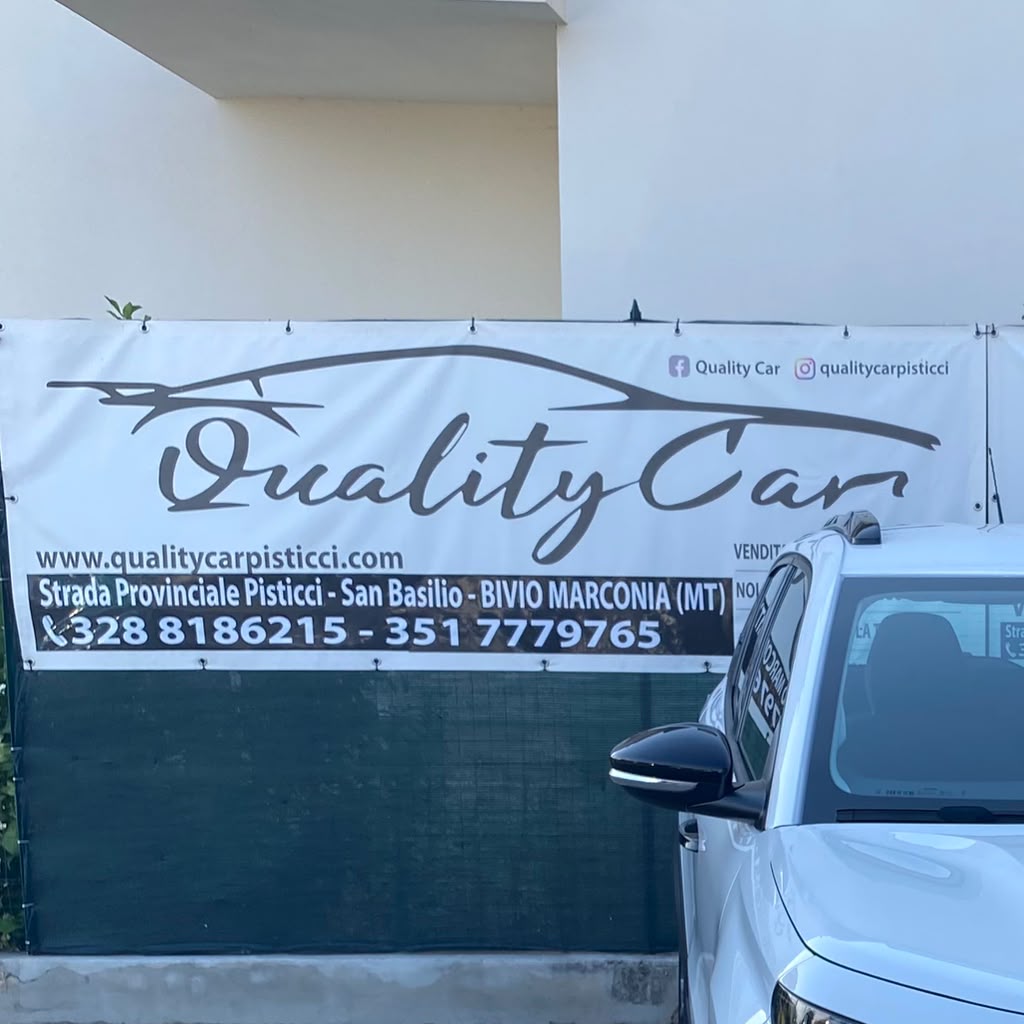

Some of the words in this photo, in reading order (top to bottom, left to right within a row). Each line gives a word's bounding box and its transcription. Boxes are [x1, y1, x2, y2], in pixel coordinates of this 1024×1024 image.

[695, 360, 751, 378] Quality
[755, 361, 781, 376] Car
[820, 360, 949, 378] qualitycarpisticci
[158, 412, 622, 565] Quality
[639, 417, 909, 511] Car
[36, 545, 404, 575] www.qualitycarpisticci.com
[733, 543, 786, 560] VENDIT
[39, 576, 111, 607] Strada
[115, 577, 240, 607] Provinciale
[244, 577, 322, 607] Pisticci
[341, 578, 382, 607] San
[388, 578, 462, 608] Basilio
[480, 580, 543, 608] BIVIO
[549, 580, 671, 611] MARCONIA
[676, 581, 726, 616] (MT)
[71, 616, 148, 645] 328
[158, 616, 347, 645] 8186215
[385, 617, 460, 646] 351
[476, 618, 661, 649] 7779765
